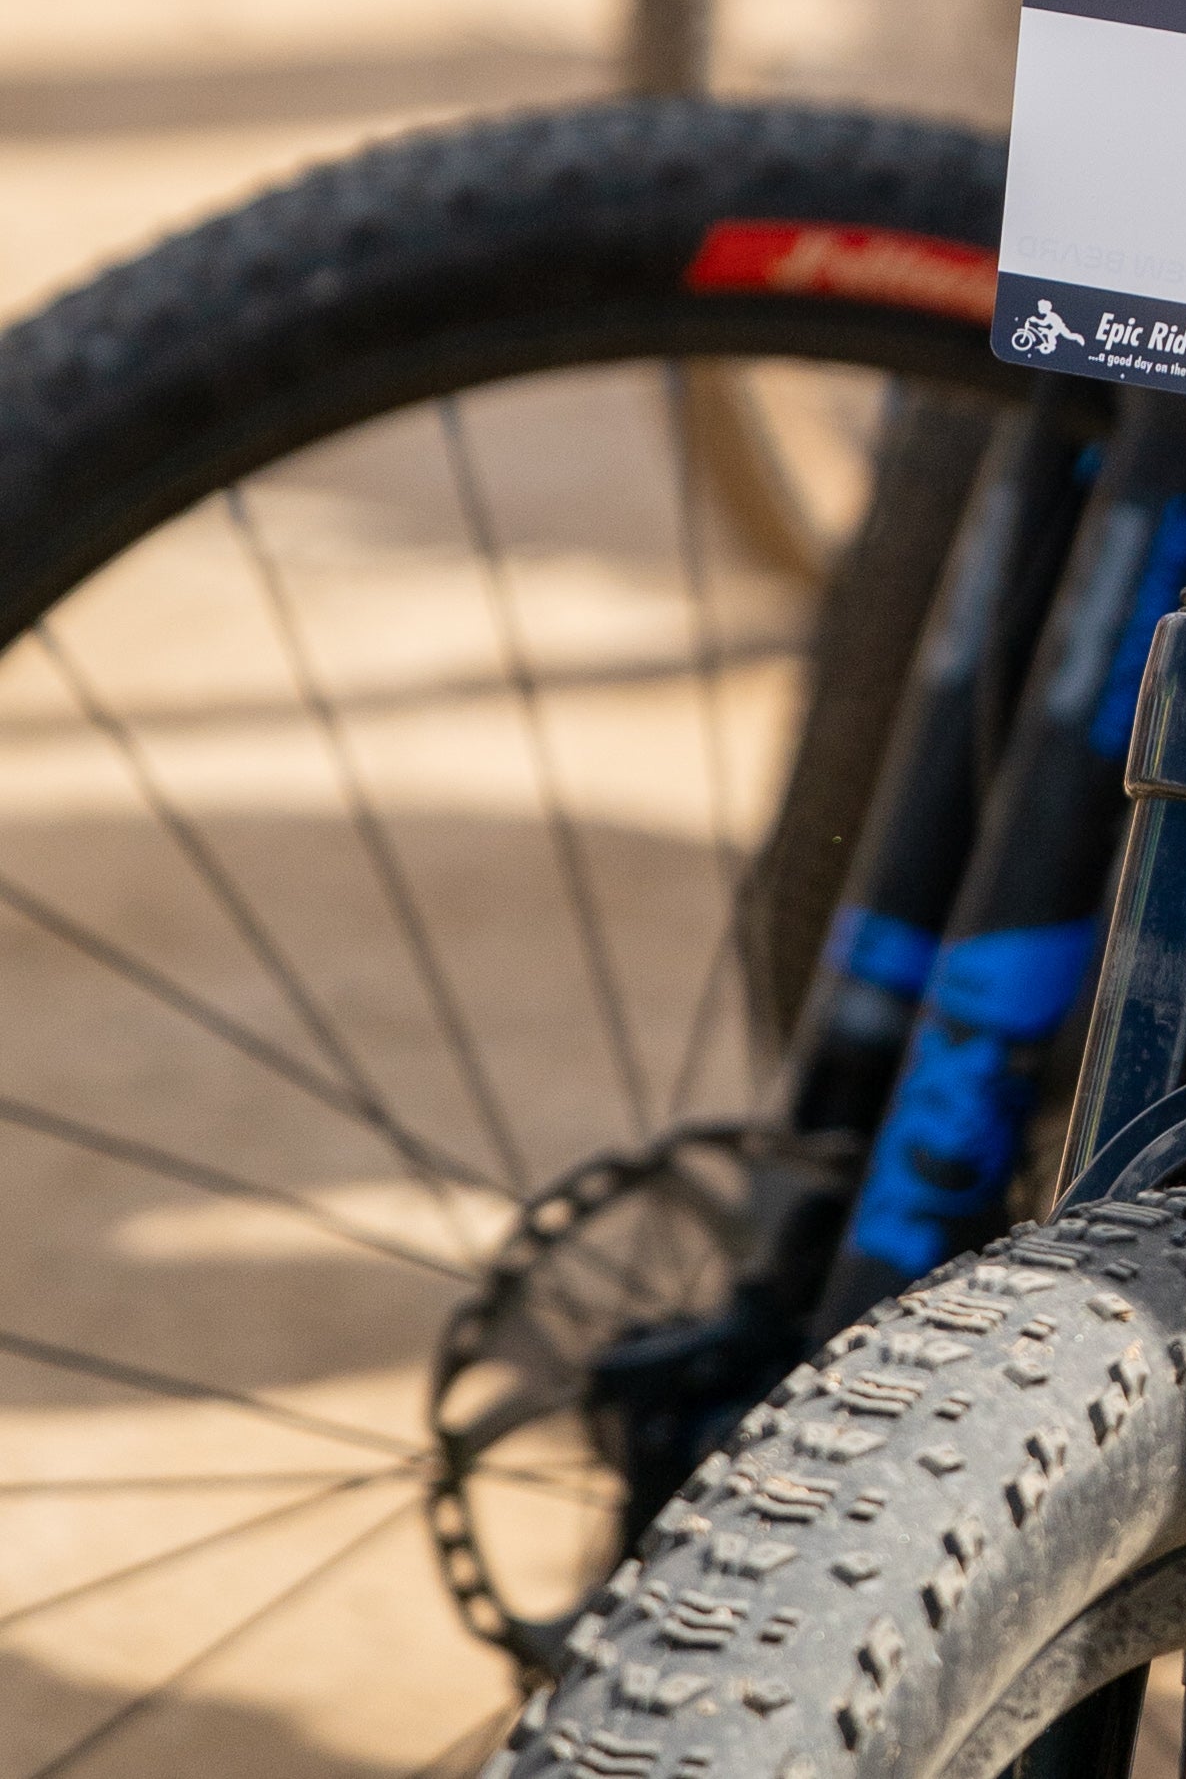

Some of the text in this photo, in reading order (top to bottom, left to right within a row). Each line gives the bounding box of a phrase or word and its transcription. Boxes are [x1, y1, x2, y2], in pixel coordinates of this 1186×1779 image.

[1095, 312, 1143, 350] Epic
[1107, 354, 1132, 368] good
[1134, 357, 1153, 373] day
[1155, 363, 1168, 373] on
[1170, 363, 1186, 378] the
